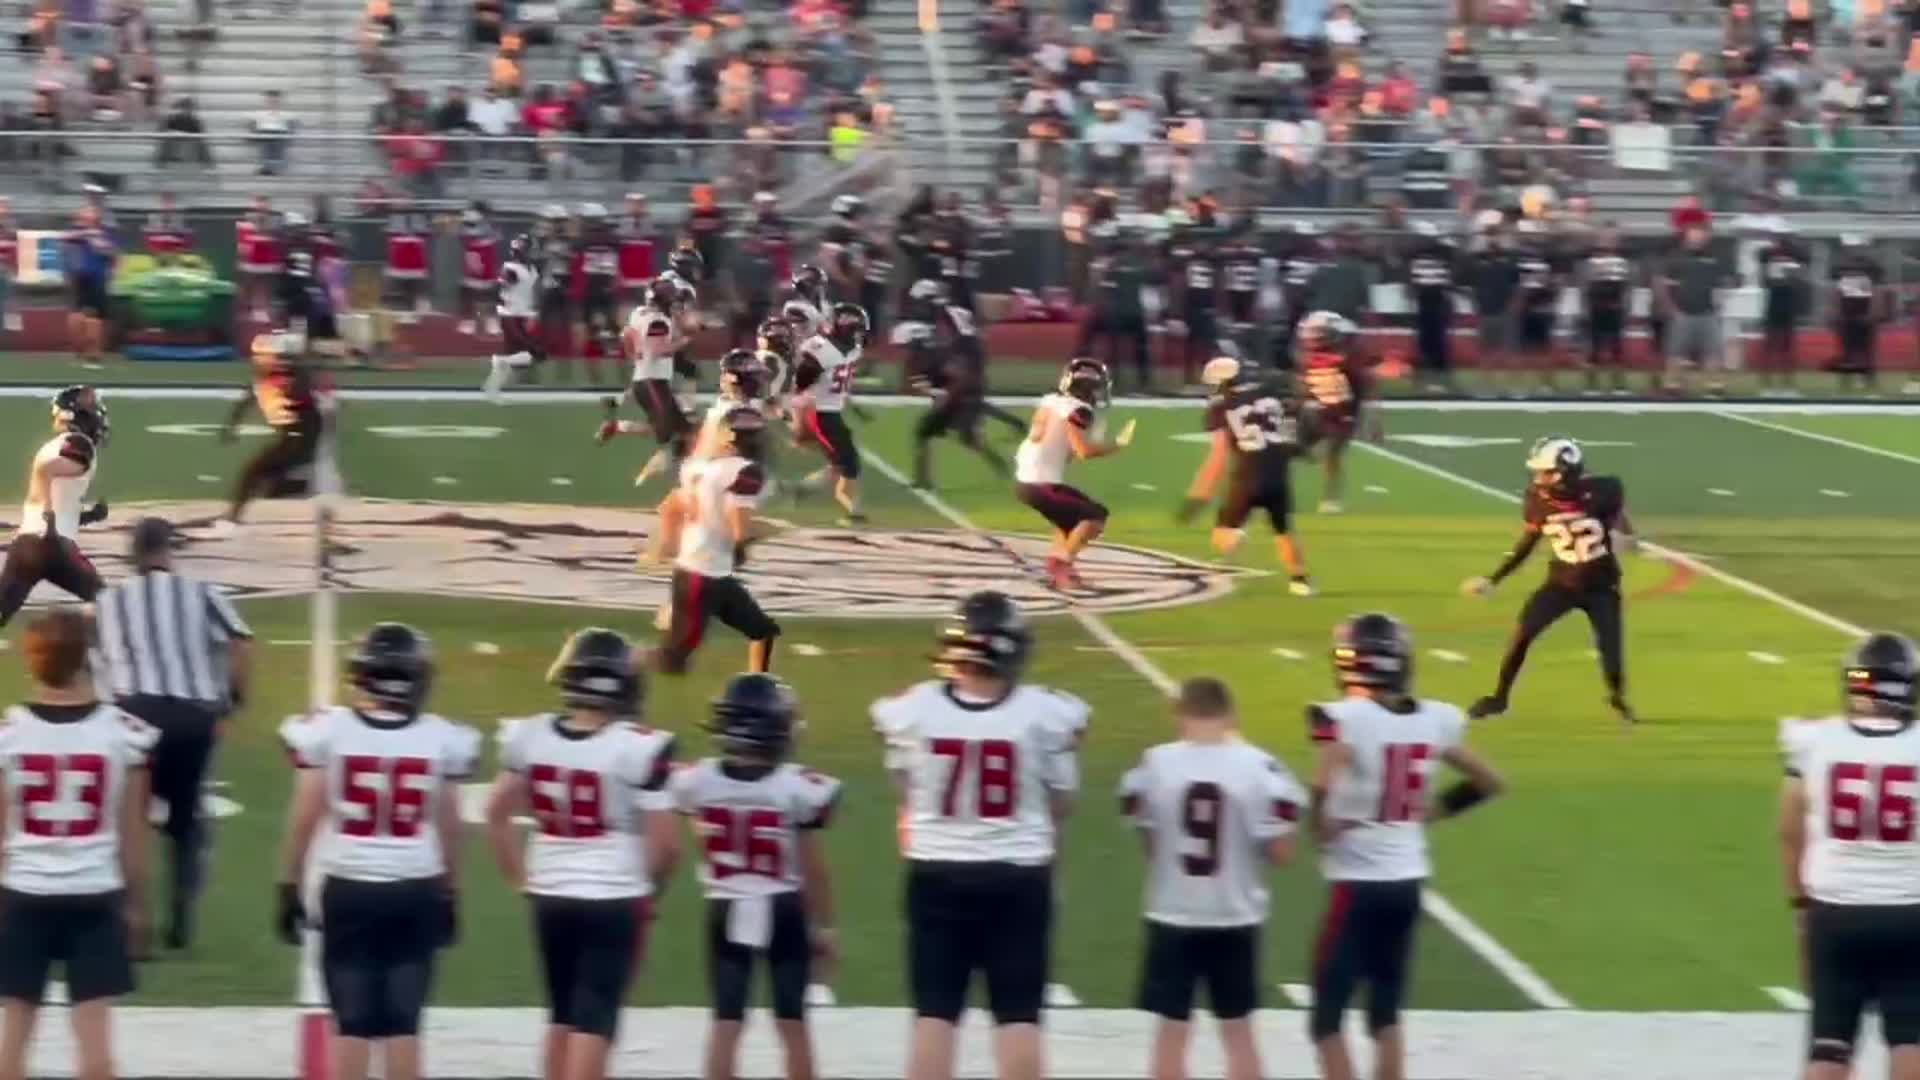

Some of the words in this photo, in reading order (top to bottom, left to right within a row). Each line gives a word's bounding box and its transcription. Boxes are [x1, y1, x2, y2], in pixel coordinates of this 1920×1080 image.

[1541, 516, 1609, 564] 22
[19, 754, 107, 838] 23
[341, 755, 431, 838] 56
[929, 738, 1017, 818] 78
[1830, 762, 1917, 841] 66
[703, 806, 783, 879] 26
[1183, 781, 1222, 877] 9
